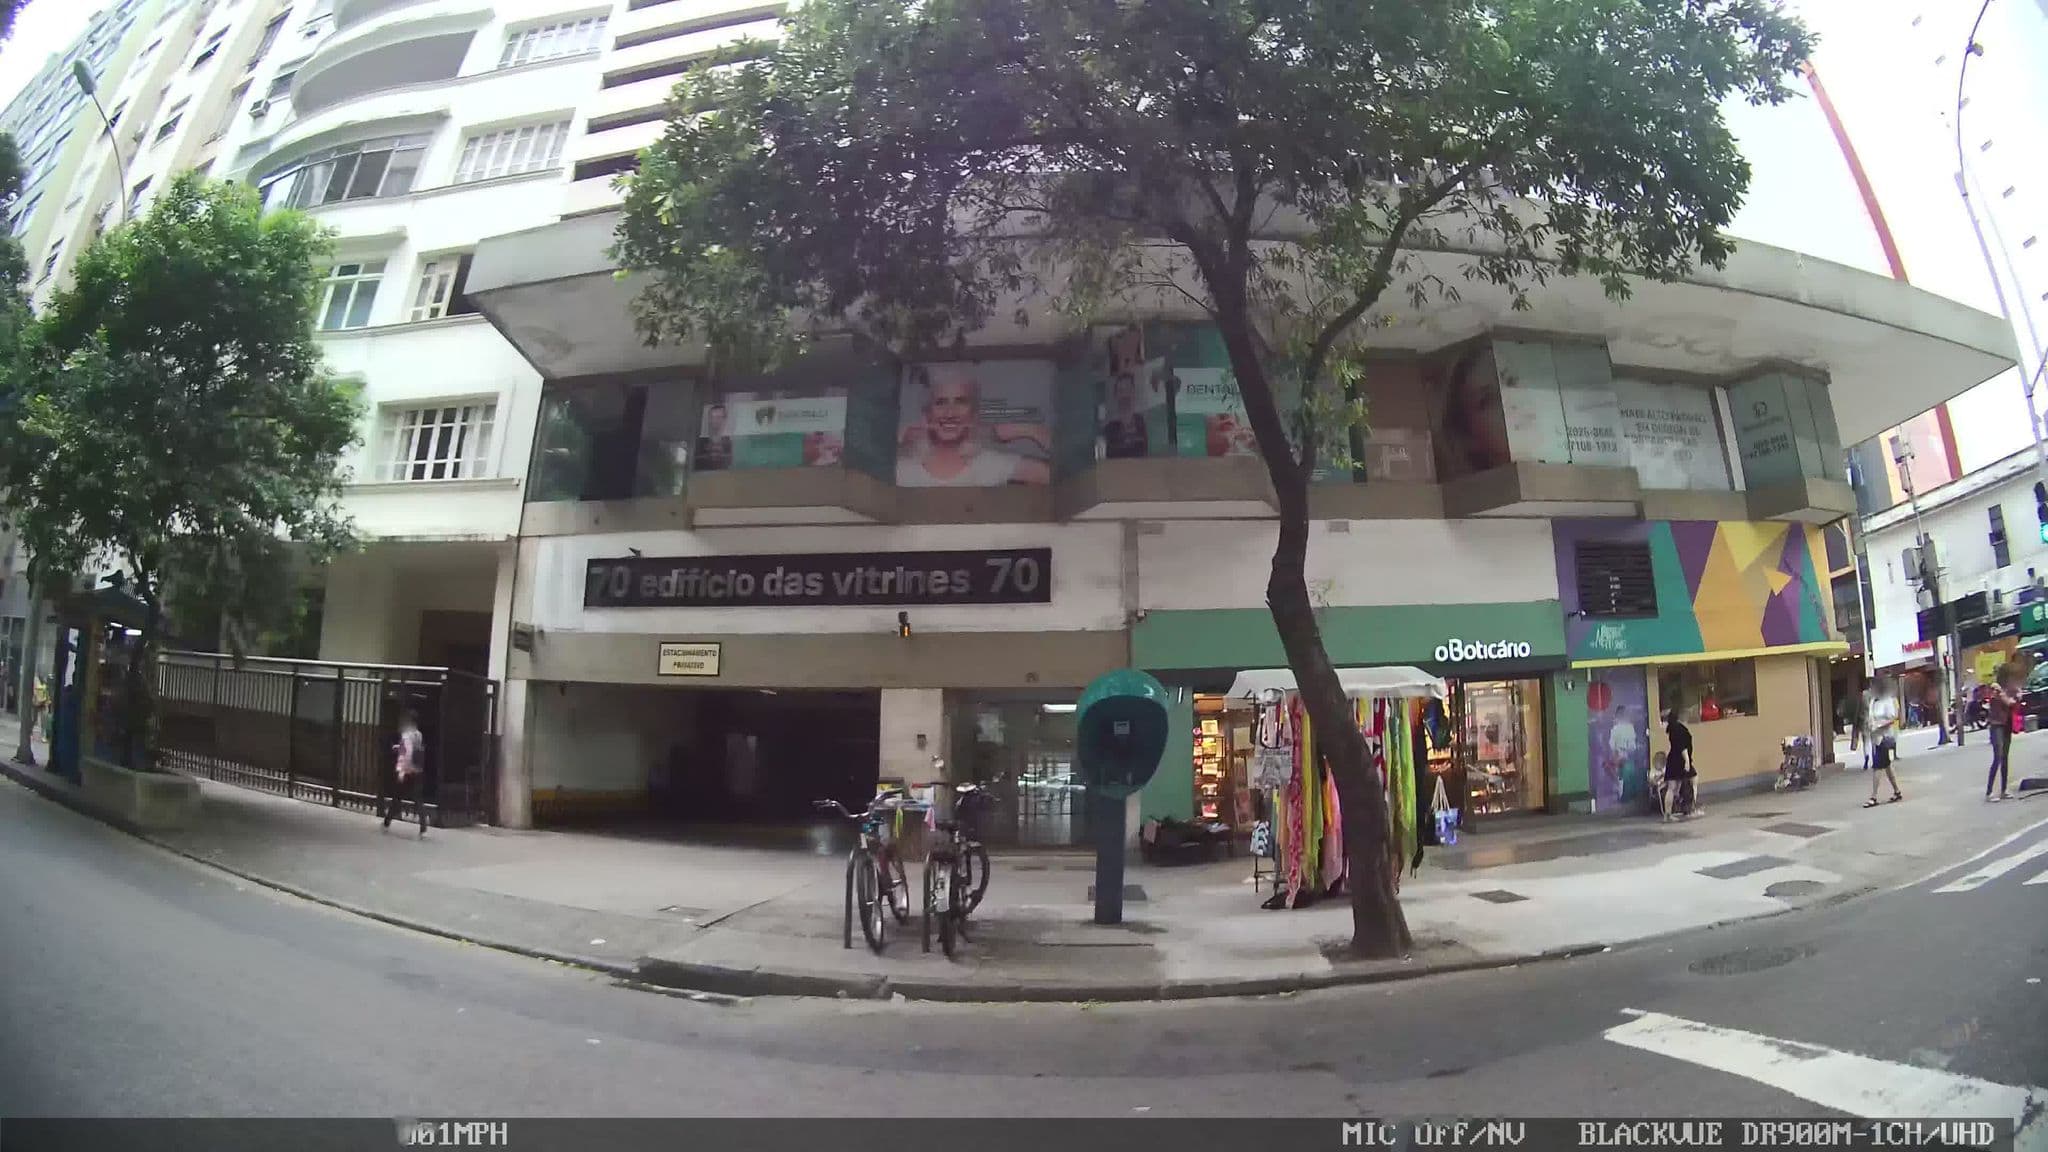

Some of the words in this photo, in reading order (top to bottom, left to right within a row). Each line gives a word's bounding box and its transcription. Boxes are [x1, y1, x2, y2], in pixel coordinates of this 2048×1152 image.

[591, 566, 631, 598] 70
[763, 565, 824, 597] das
[832, 566, 971, 596] vitrines
[986, 556, 1041, 593] 70
